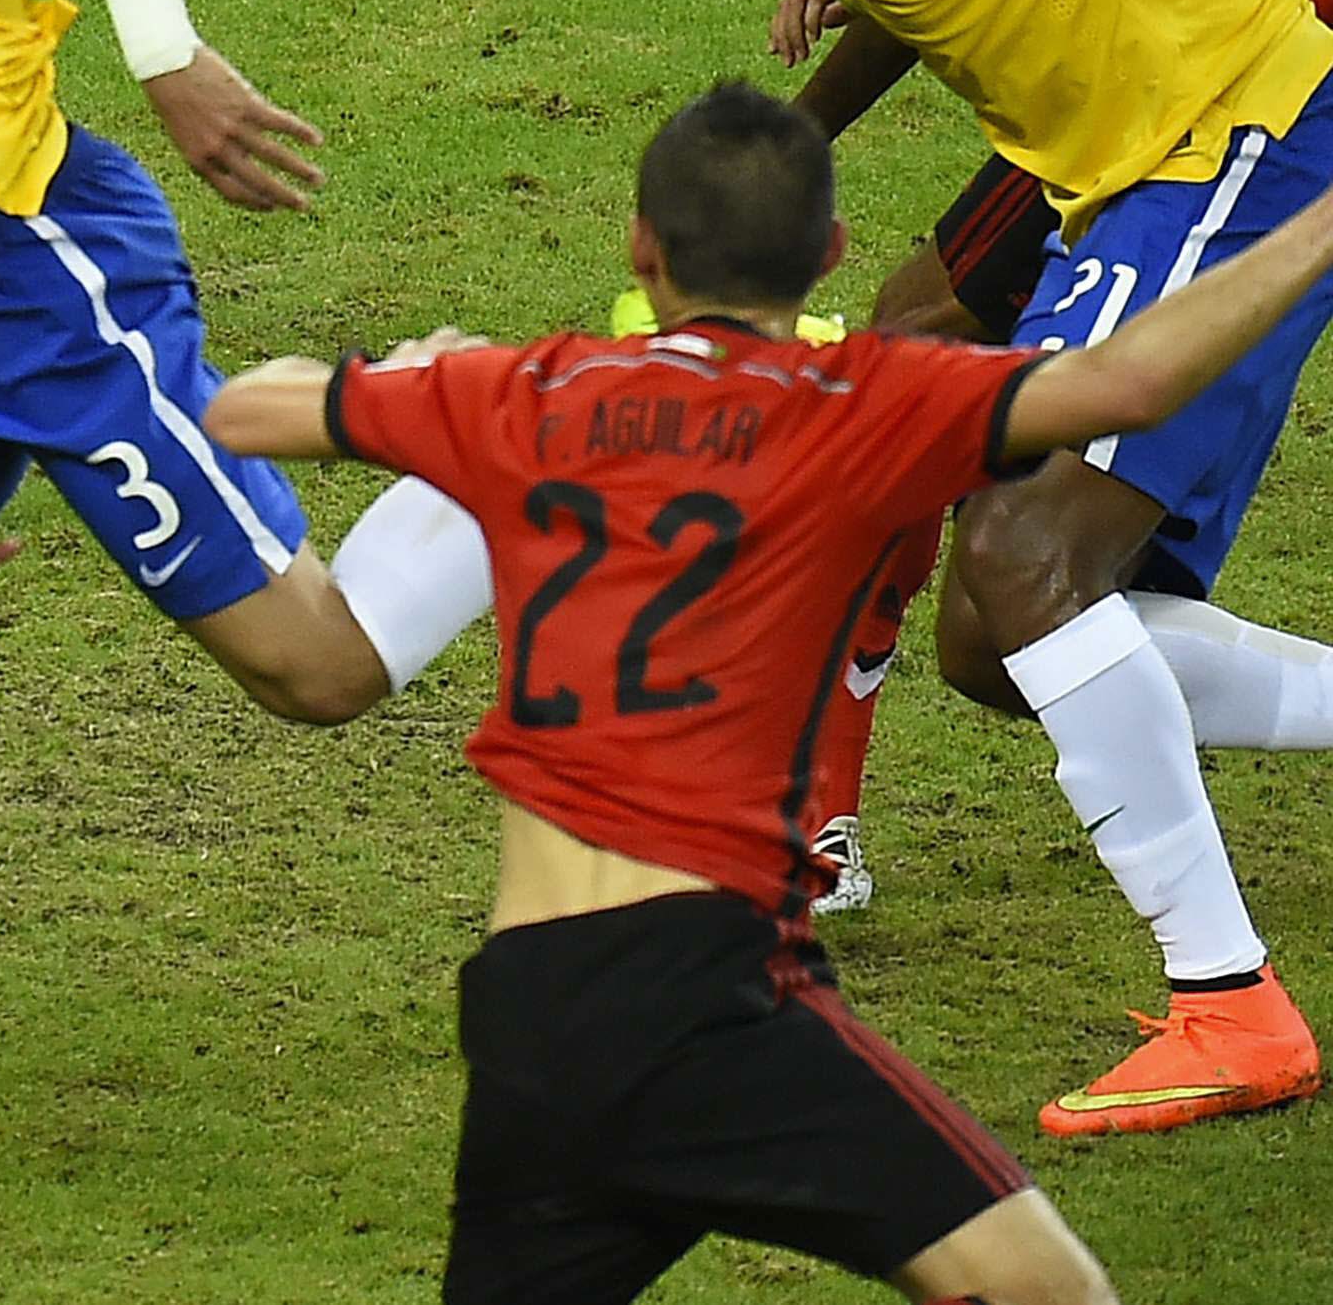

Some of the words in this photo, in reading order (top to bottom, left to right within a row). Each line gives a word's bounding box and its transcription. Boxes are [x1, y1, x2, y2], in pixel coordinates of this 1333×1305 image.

[586, 397, 763, 466] AGUILAR
[87, 440, 181, 549] 3
[512, 479, 745, 728] 22
